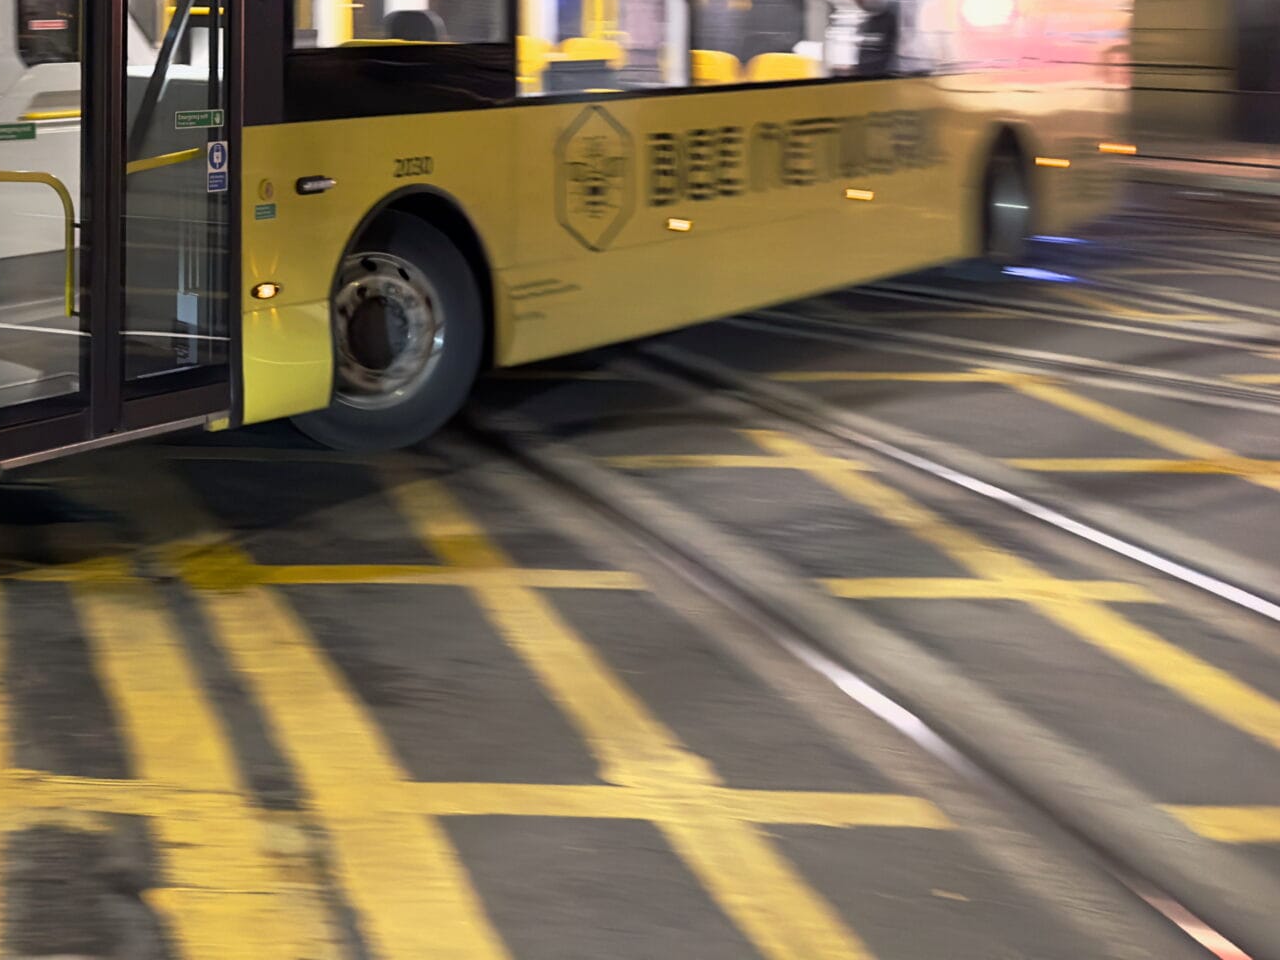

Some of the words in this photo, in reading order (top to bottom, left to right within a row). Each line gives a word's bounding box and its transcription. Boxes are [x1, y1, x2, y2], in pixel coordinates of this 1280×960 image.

[393, 156, 434, 178] 2030
[647, 125, 745, 208] BEE
[749, 109, 948, 192] NETOR
